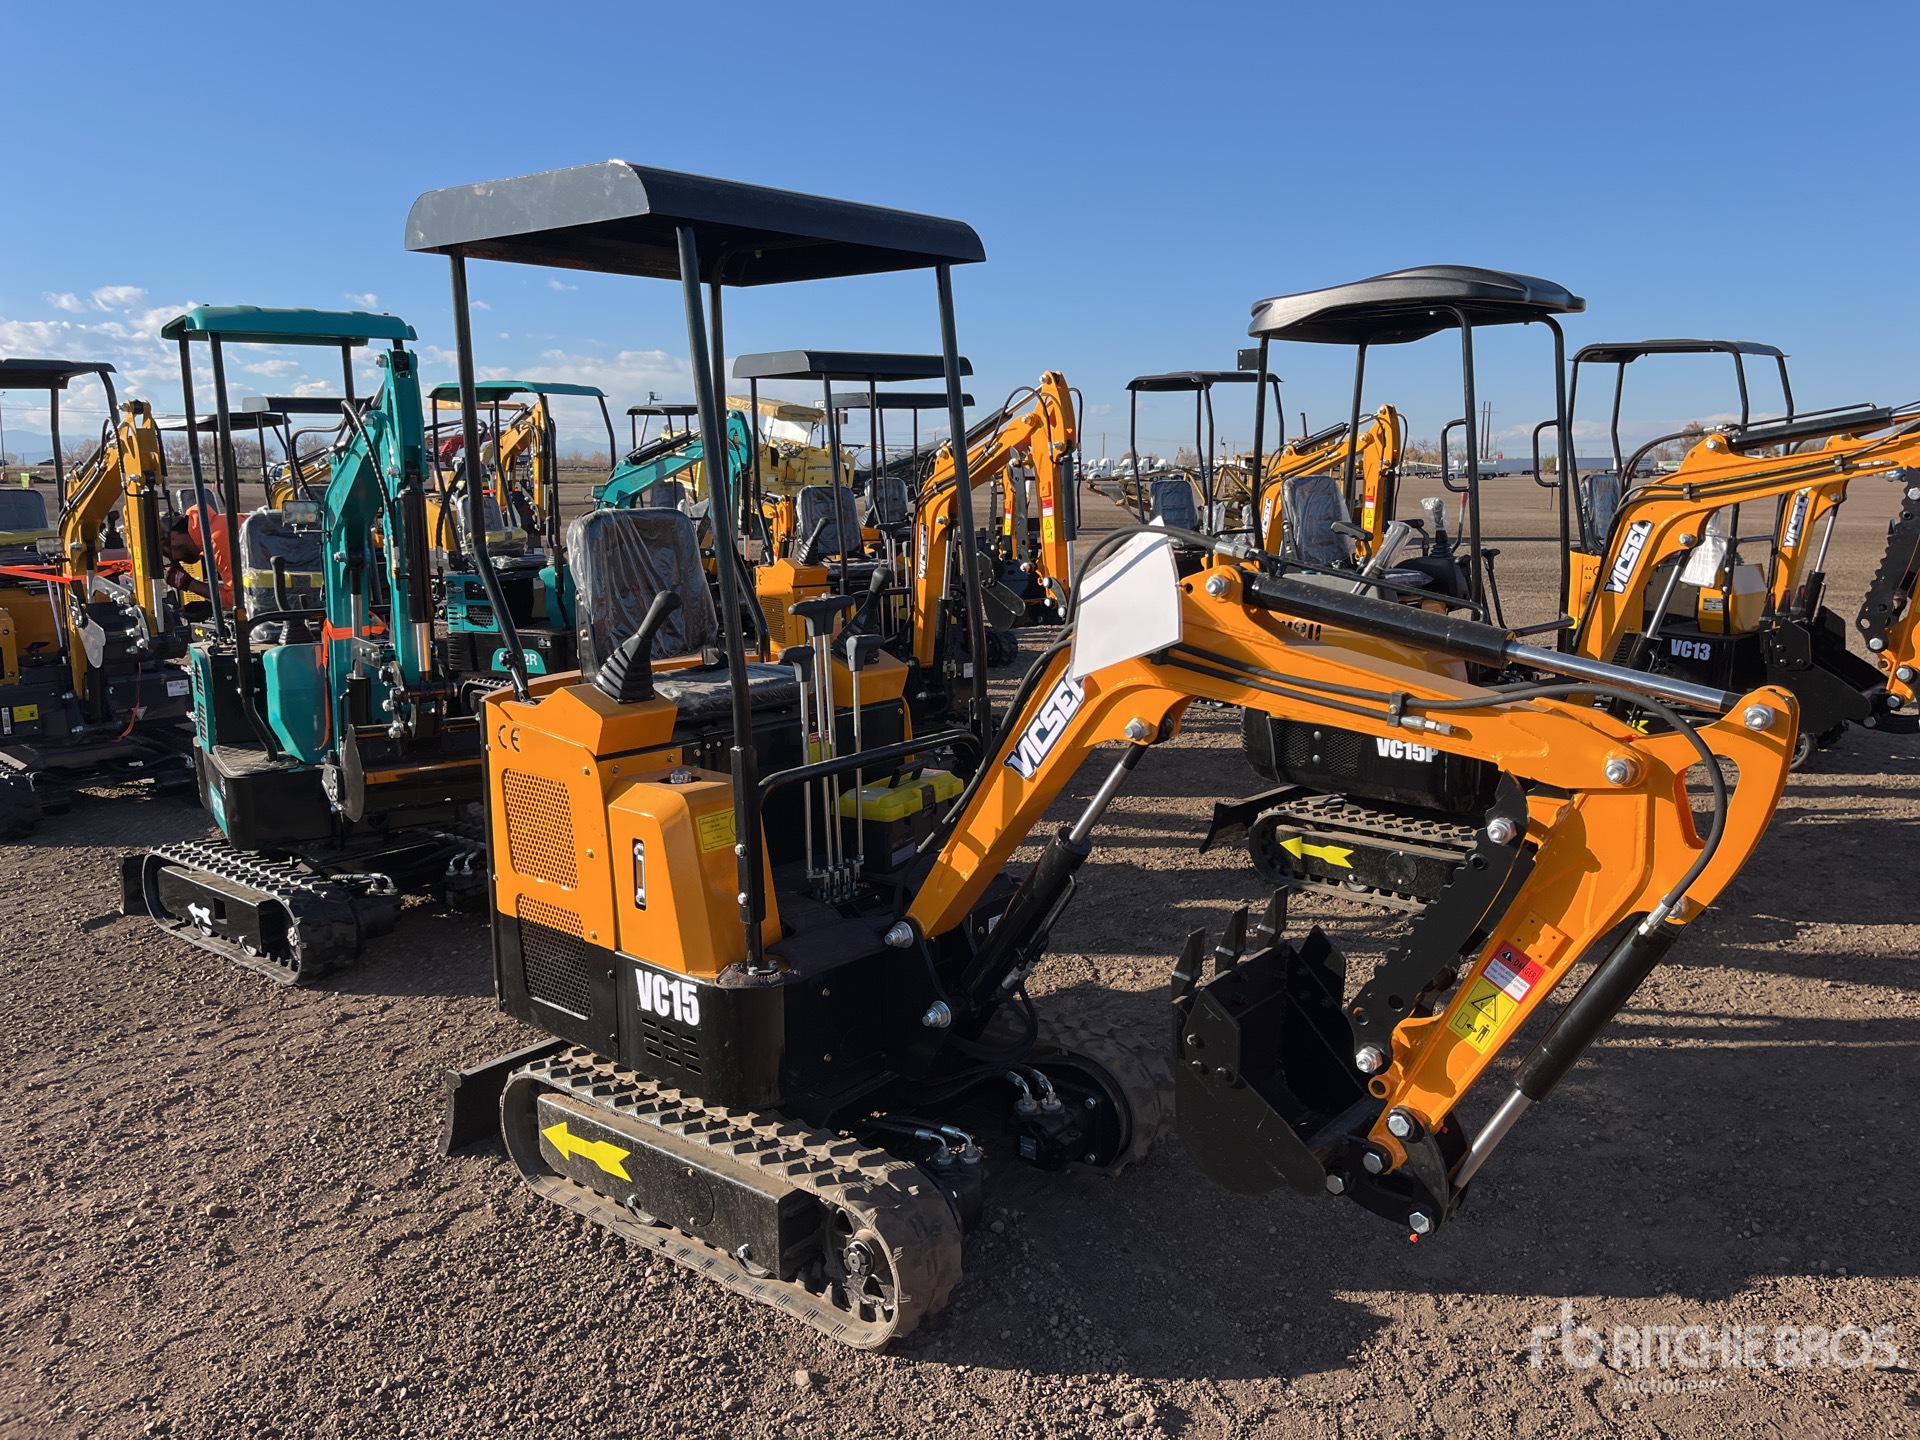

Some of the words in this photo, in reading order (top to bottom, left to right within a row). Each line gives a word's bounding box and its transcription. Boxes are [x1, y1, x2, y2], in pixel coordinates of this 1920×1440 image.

[1783, 494, 1809, 547] VICSEL
[1604, 520, 1652, 593] VICSEL
[1671, 638, 1711, 661] VC13
[498, 724, 521, 753] CE
[1004, 668, 1085, 779] VICSEL
[1376, 737, 1439, 763] VC15P
[1513, 959, 1537, 980] DANGER
[635, 968, 700, 1026] VC15
